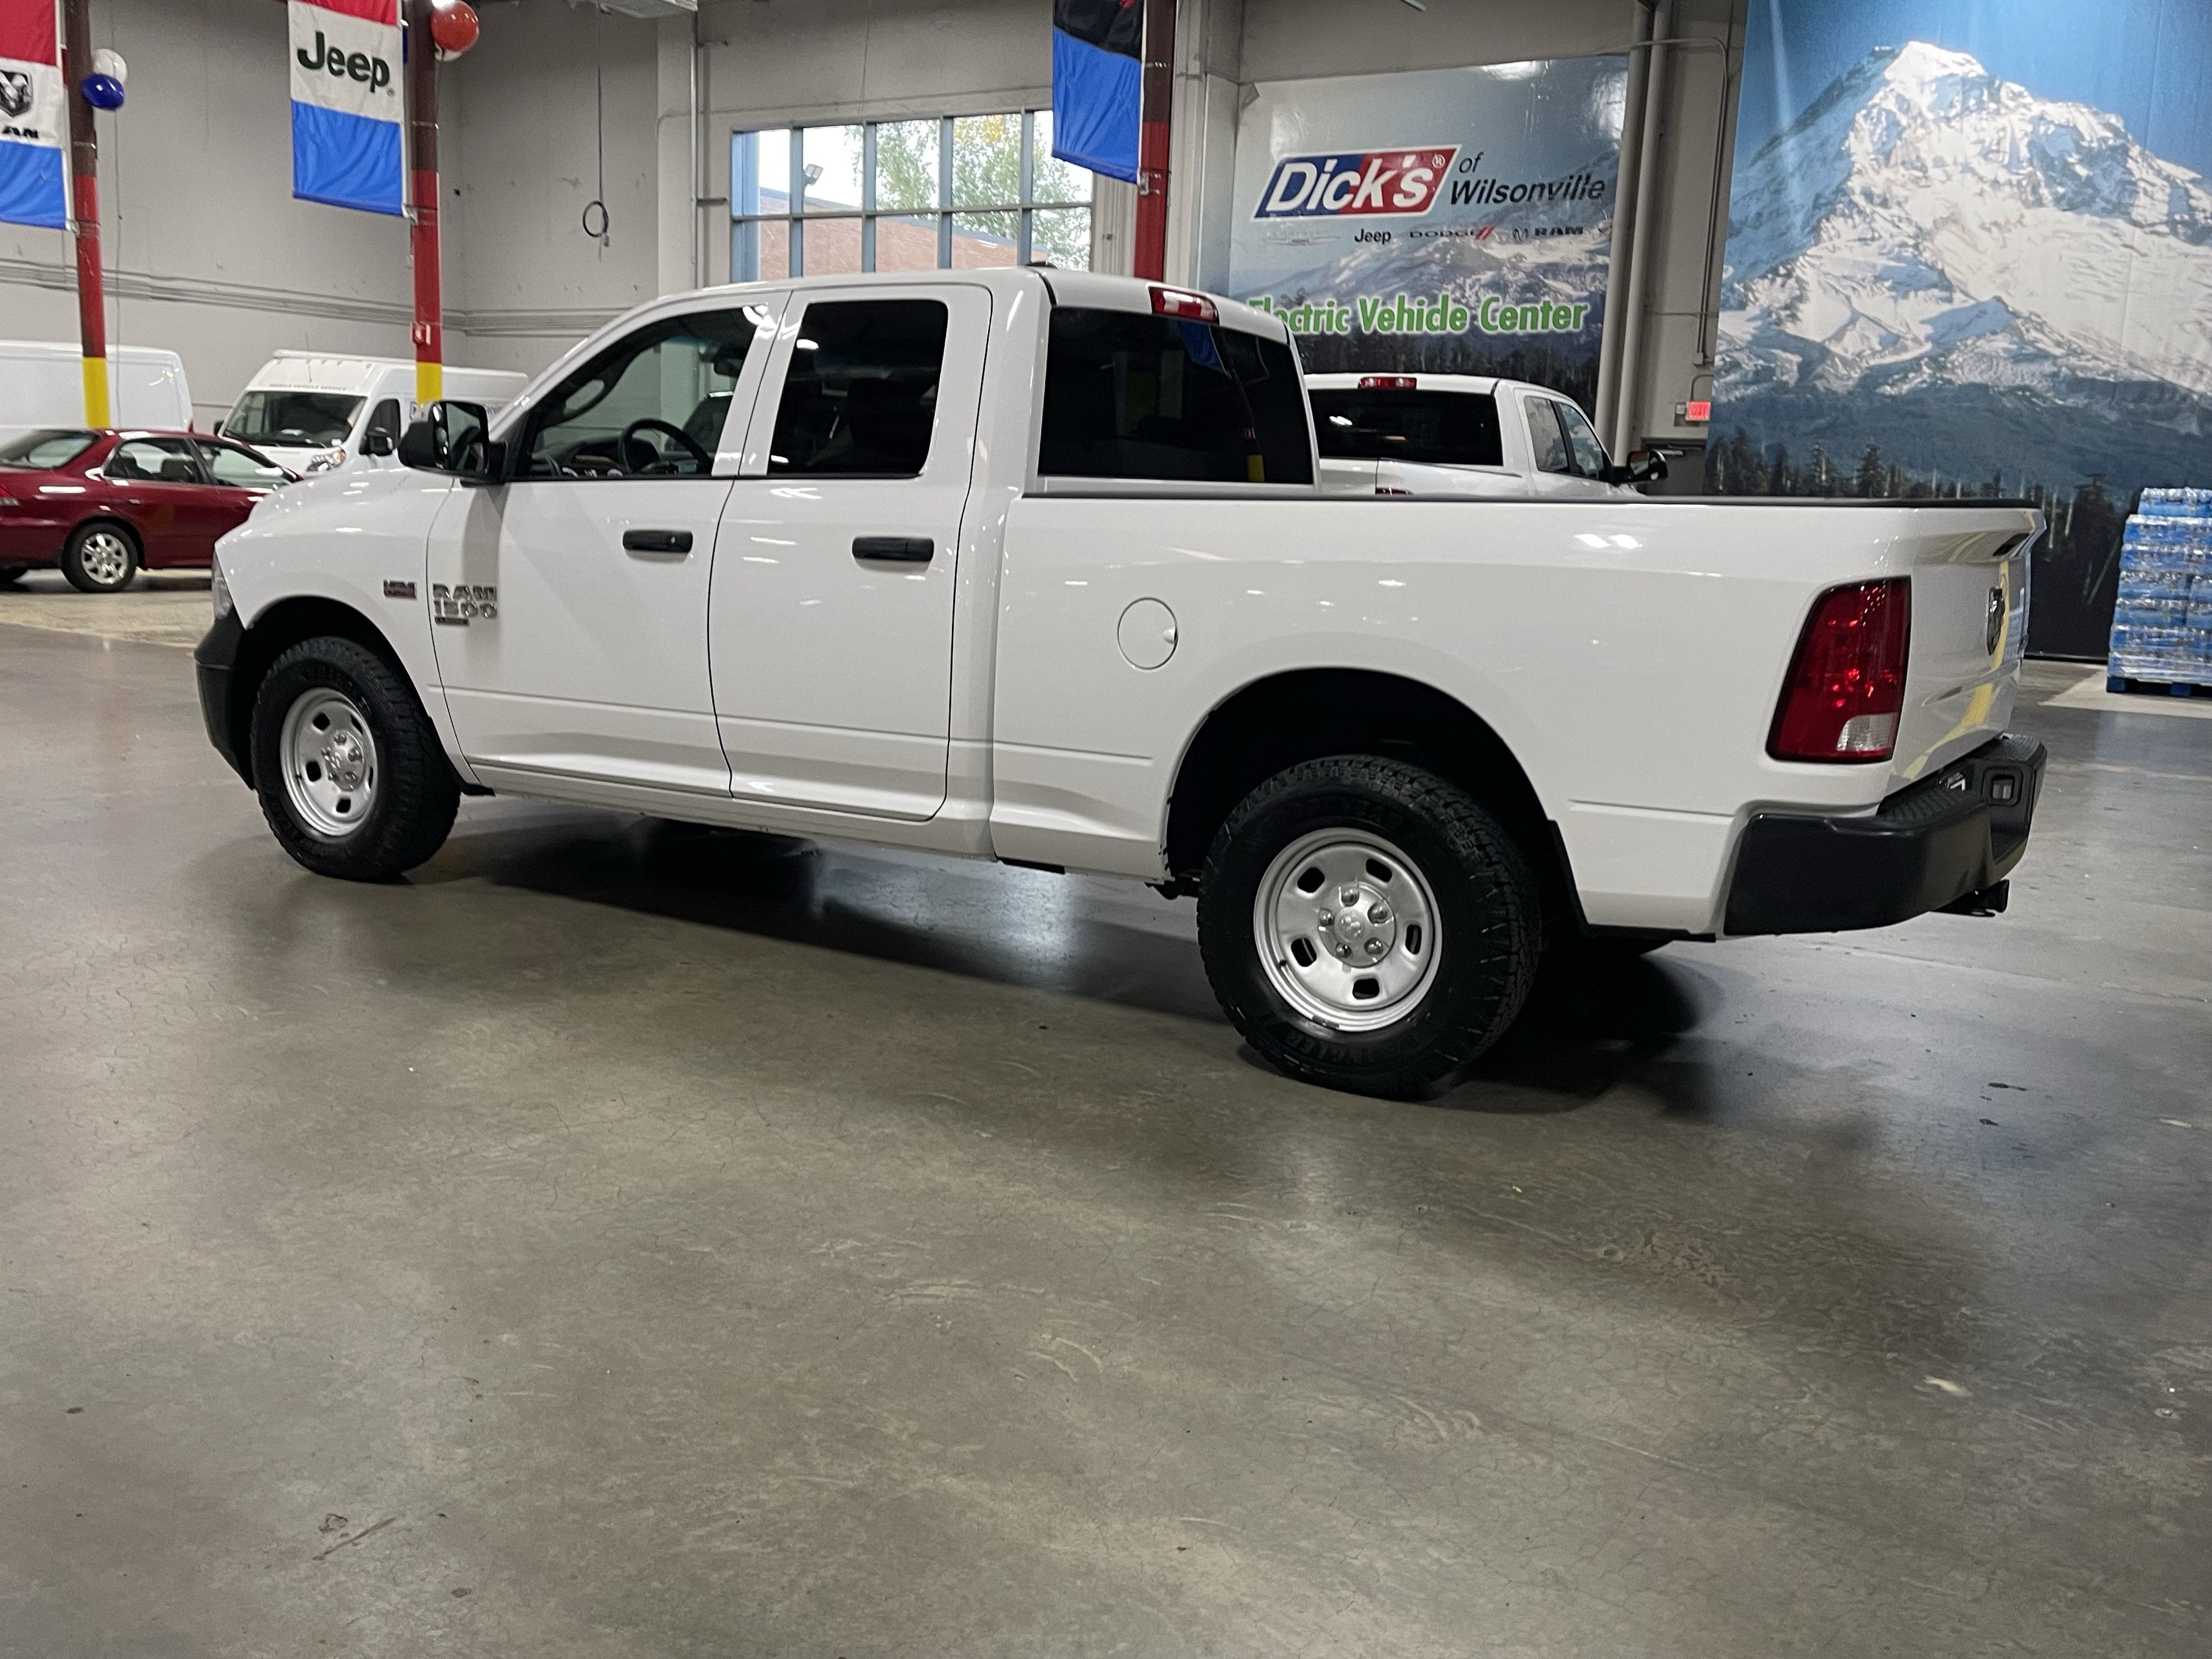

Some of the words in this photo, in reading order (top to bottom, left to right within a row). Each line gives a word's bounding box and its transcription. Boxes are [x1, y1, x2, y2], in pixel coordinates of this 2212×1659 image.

[296, 30, 390, 93] Jeep
[1265, 154, 1434, 212] Dick's
[1458, 151, 1485, 174] of
[1450, 174, 1606, 205] Wilsonville
[1353, 228, 1391, 245] Jeep
[1534, 226, 1583, 236] RAM
[1358, 294, 1468, 332] Vehicle
[1480, 295, 1589, 331] Center
